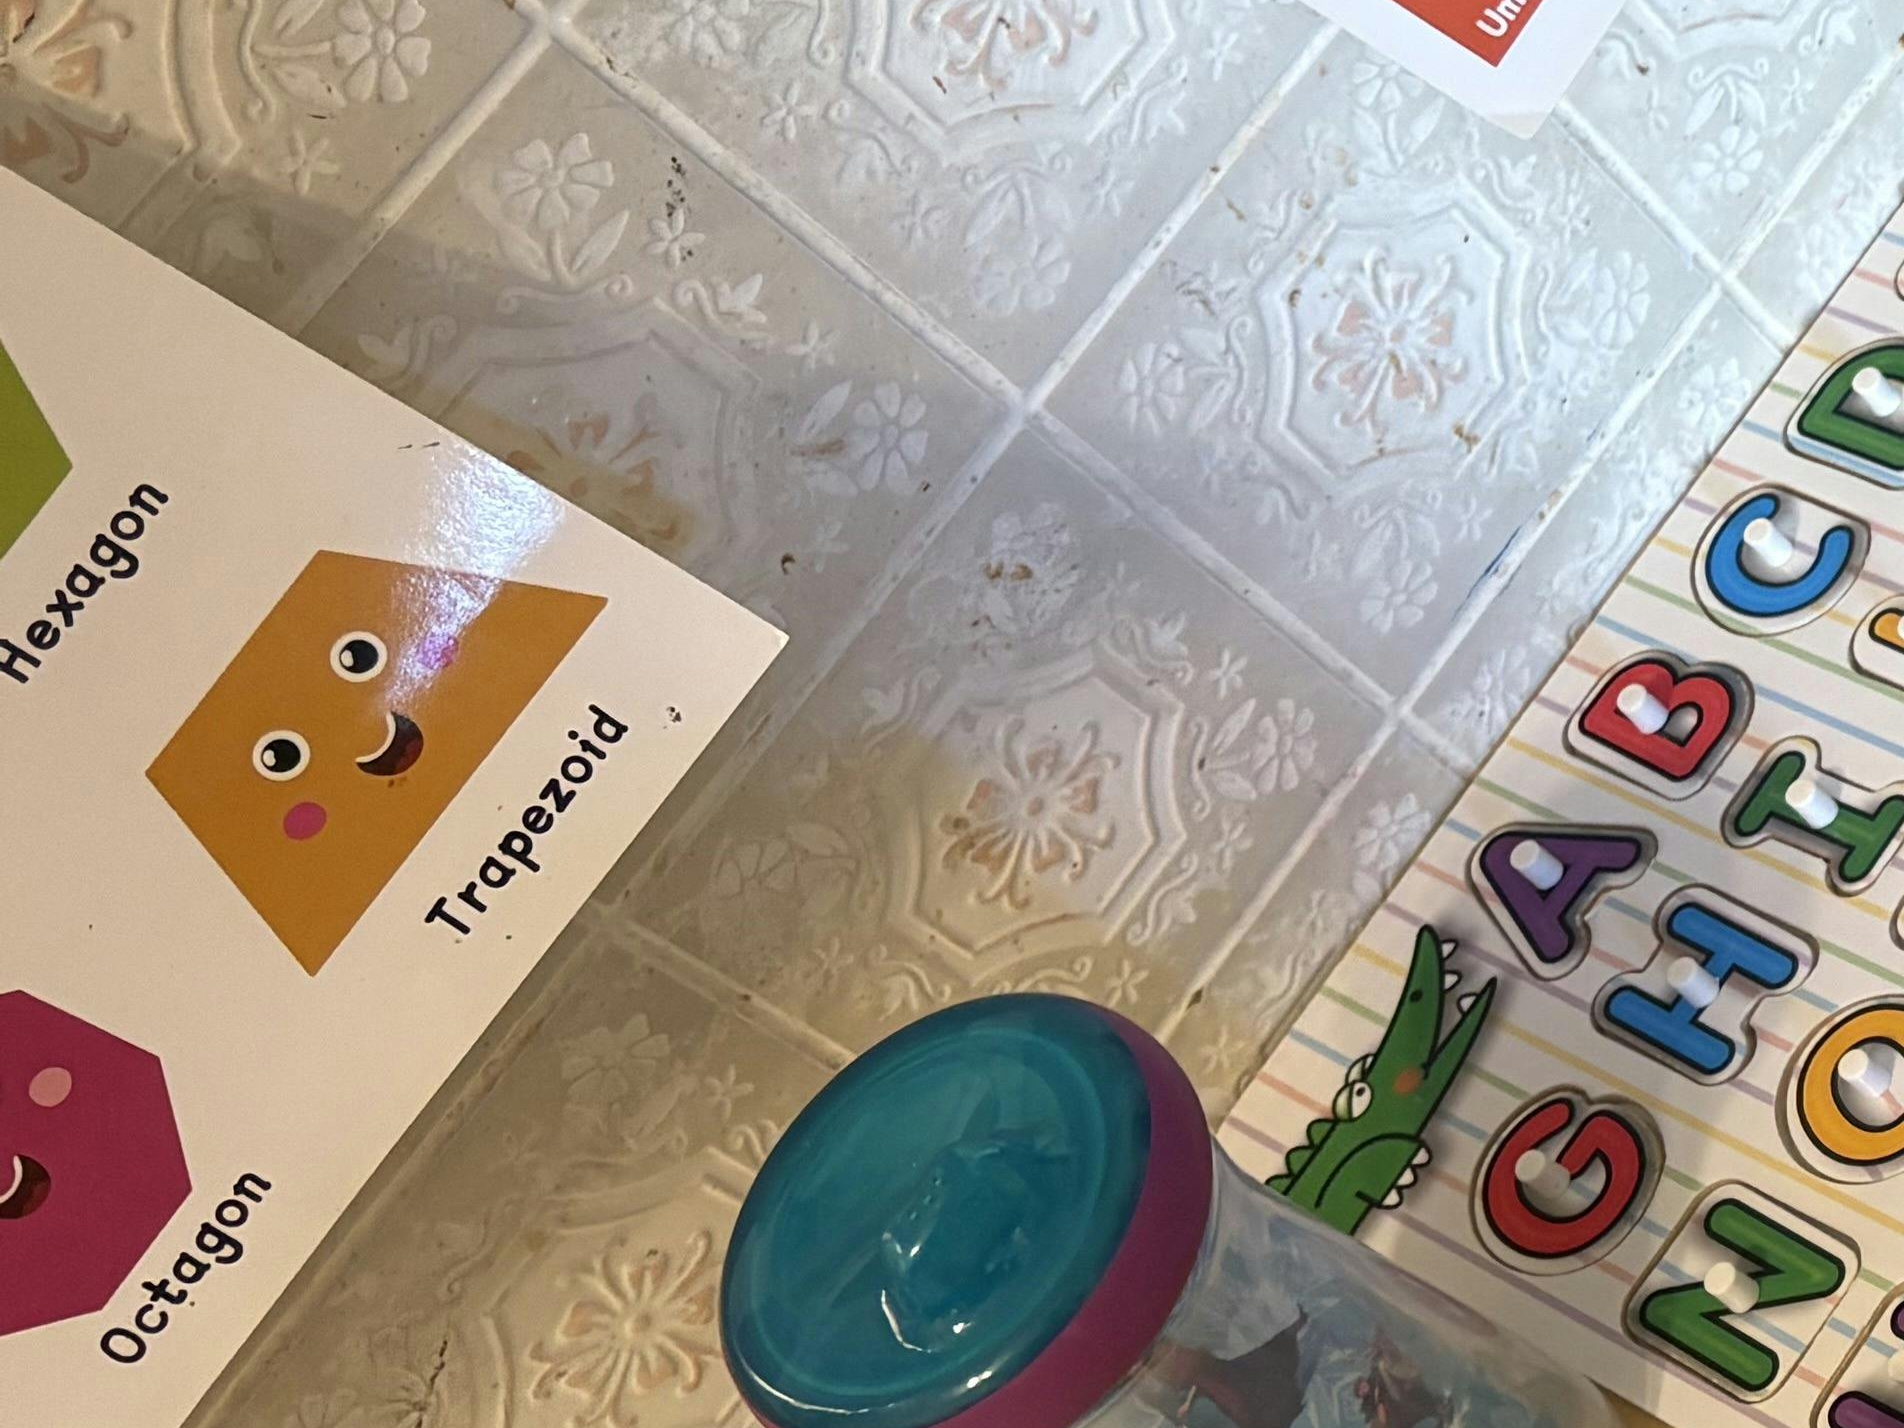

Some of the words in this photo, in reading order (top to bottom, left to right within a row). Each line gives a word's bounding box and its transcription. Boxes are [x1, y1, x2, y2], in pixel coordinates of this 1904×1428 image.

[0, 484, 168, 683] Hexagon
[425, 704, 628, 934] Trapezoid
[1479, 827, 1644, 966] A
[1578, 655, 1736, 780] B
[1705, 492, 1855, 617] C
[1481, 1097, 1646, 1261] G
[1606, 903, 1800, 1074] H
[100, 1173, 272, 1363] Octagon
[1638, 1195, 1847, 1391] N
